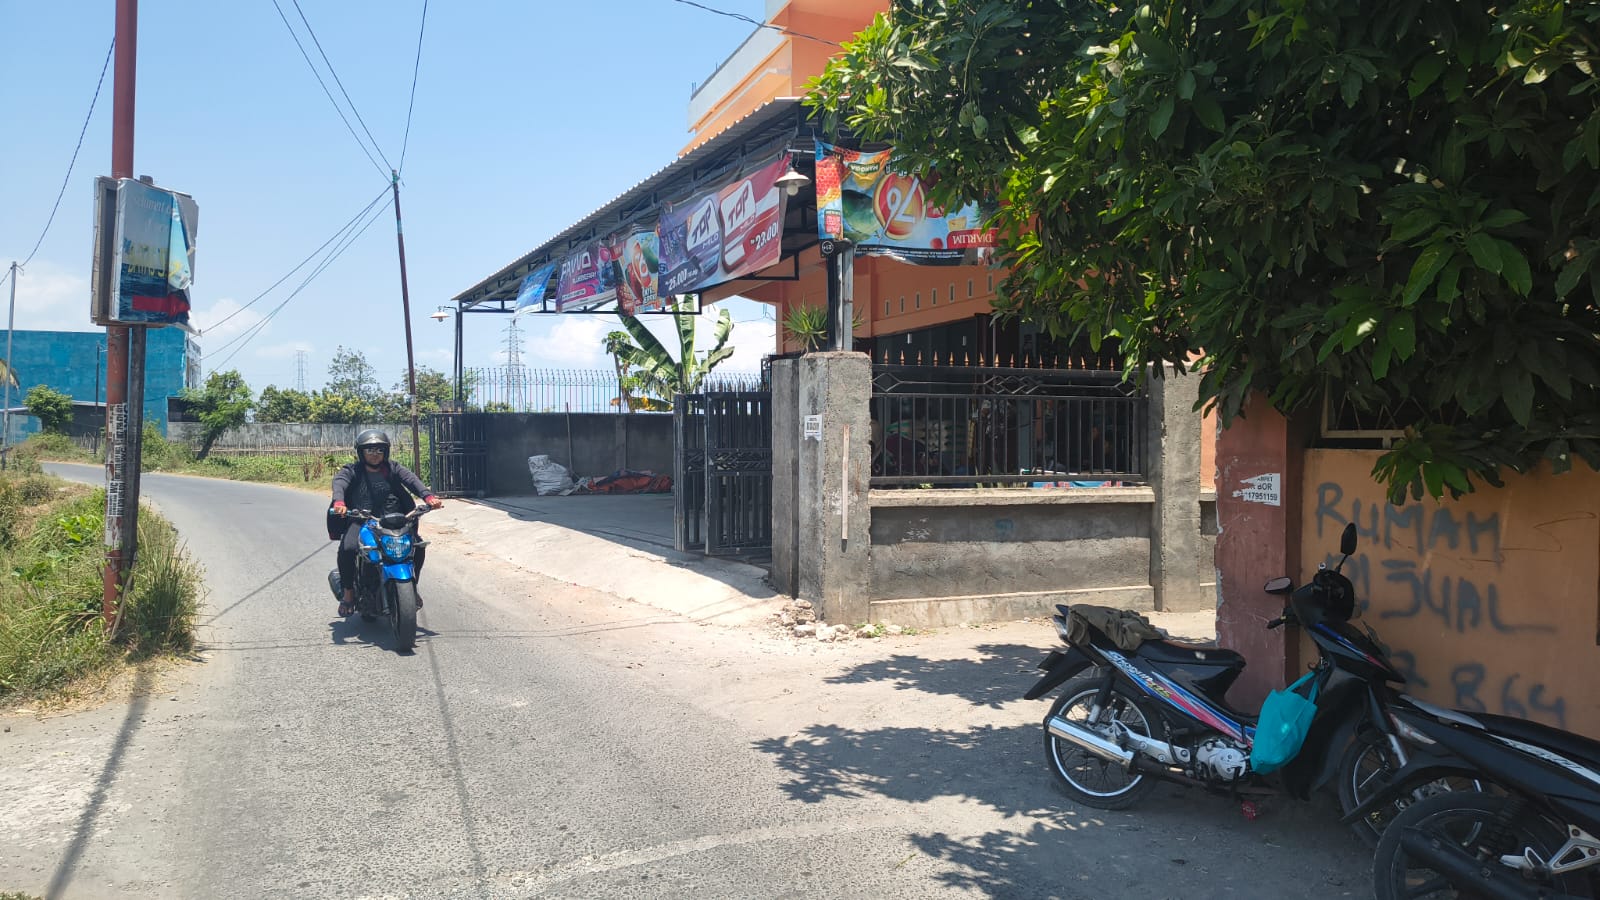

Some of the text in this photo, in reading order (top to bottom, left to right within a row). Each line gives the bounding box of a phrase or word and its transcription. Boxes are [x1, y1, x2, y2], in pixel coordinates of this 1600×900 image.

[692, 203, 712, 244] TOP
[728, 184, 749, 228] TOP
[952, 233, 993, 245] DJARUM
[1315, 482, 1501, 556] RUMAH
